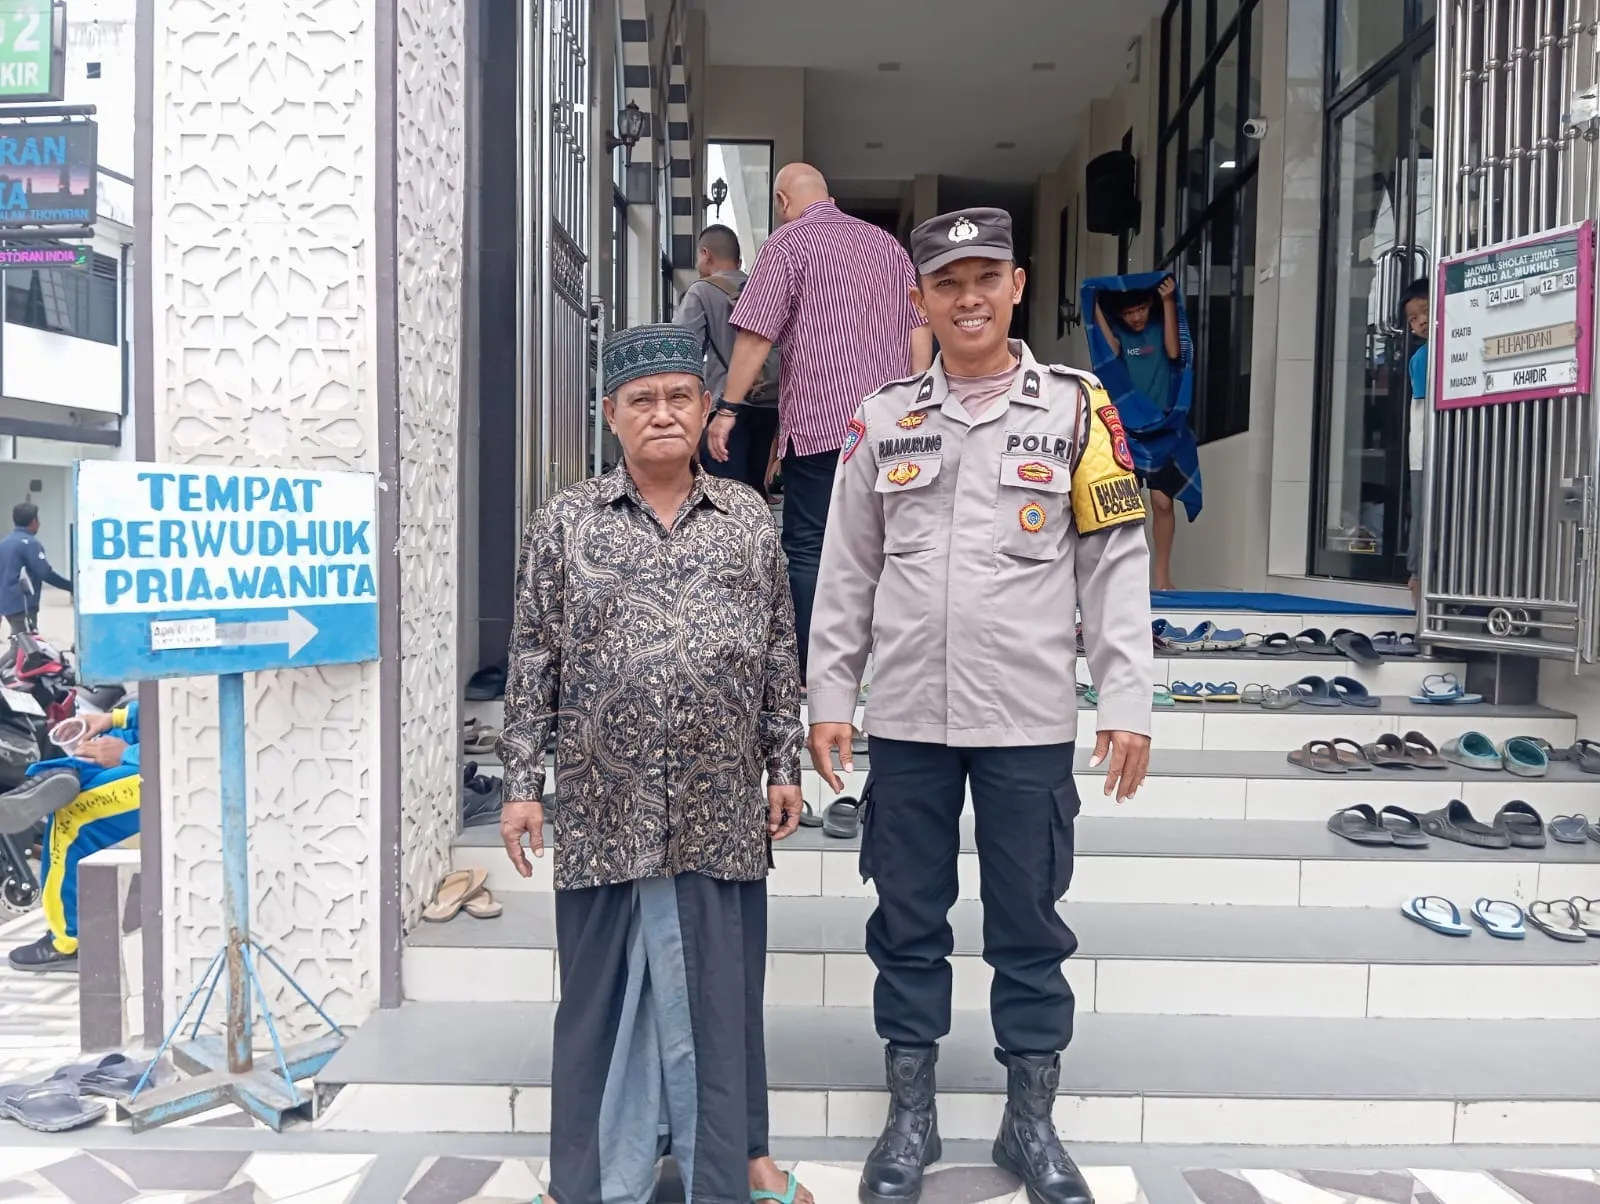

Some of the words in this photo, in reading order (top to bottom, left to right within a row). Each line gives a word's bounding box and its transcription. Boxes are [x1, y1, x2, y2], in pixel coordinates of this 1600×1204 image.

[14, 8, 41, 52] 2
[45, 251, 75, 262] INDIA
[1465, 262, 1497, 277] JADWAL
[1498, 255, 1528, 270] SHOLAT
[1464, 273, 1498, 289] MASJID
[1500, 258, 1559, 281] AL-MUKHLIS
[1489, 291, 1499, 302] 24
[1504, 289, 1520, 300] JUL
[1542, 279, 1552, 291] 12
[1564, 274, 1575, 286] 30
[1006, 434, 1073, 460] POLRI
[137, 472, 322, 513] TEMPAT
[91, 518, 371, 560] BERWUDHUK
